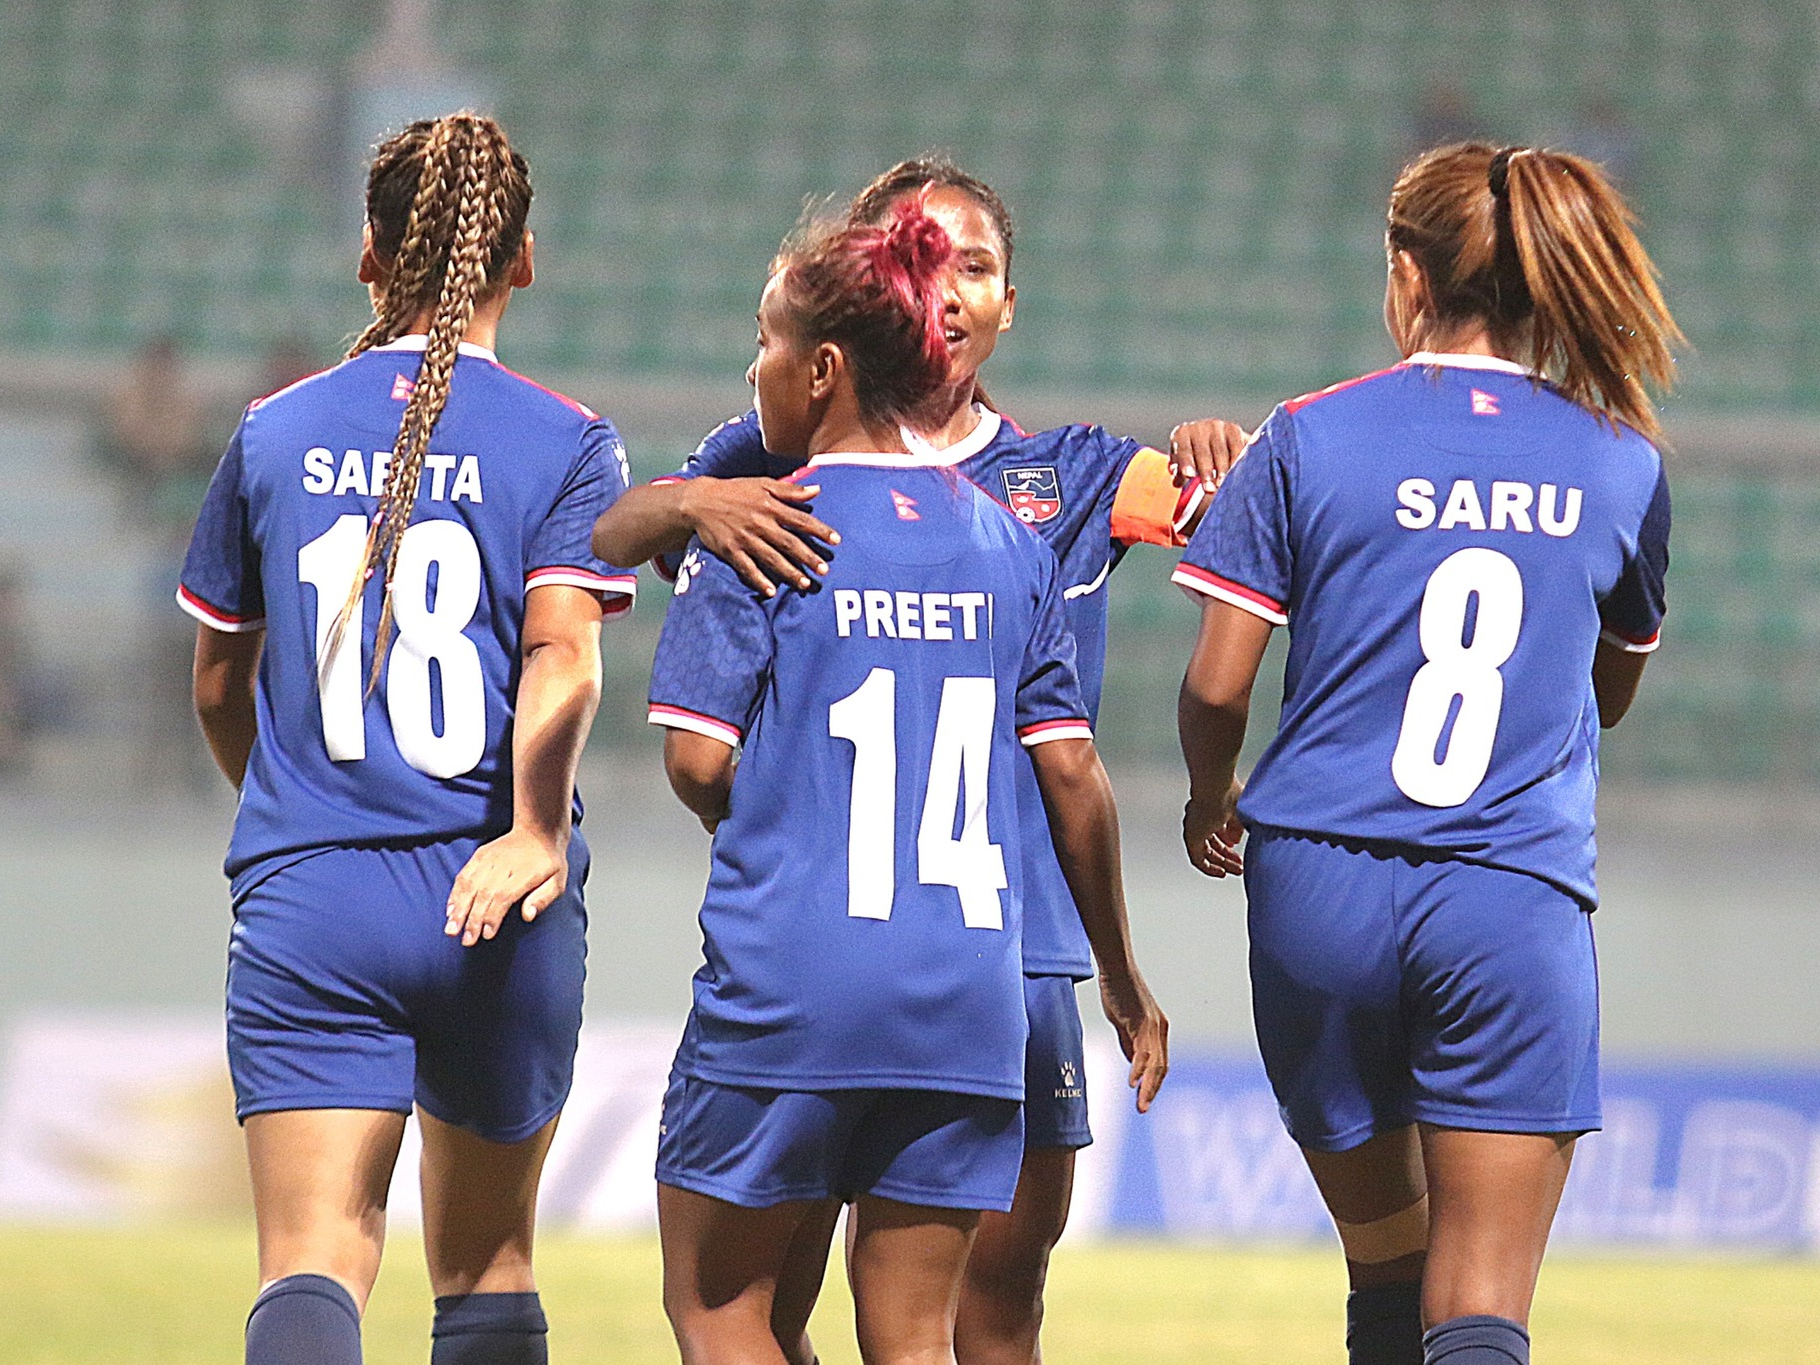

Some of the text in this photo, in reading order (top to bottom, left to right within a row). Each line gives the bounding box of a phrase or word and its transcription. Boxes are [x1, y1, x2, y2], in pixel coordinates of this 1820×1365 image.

[1395, 478, 1583, 537] SARU
[298, 514, 486, 779] 18
[1391, 547, 1524, 807] 8
[829, 667, 1008, 931] 14
